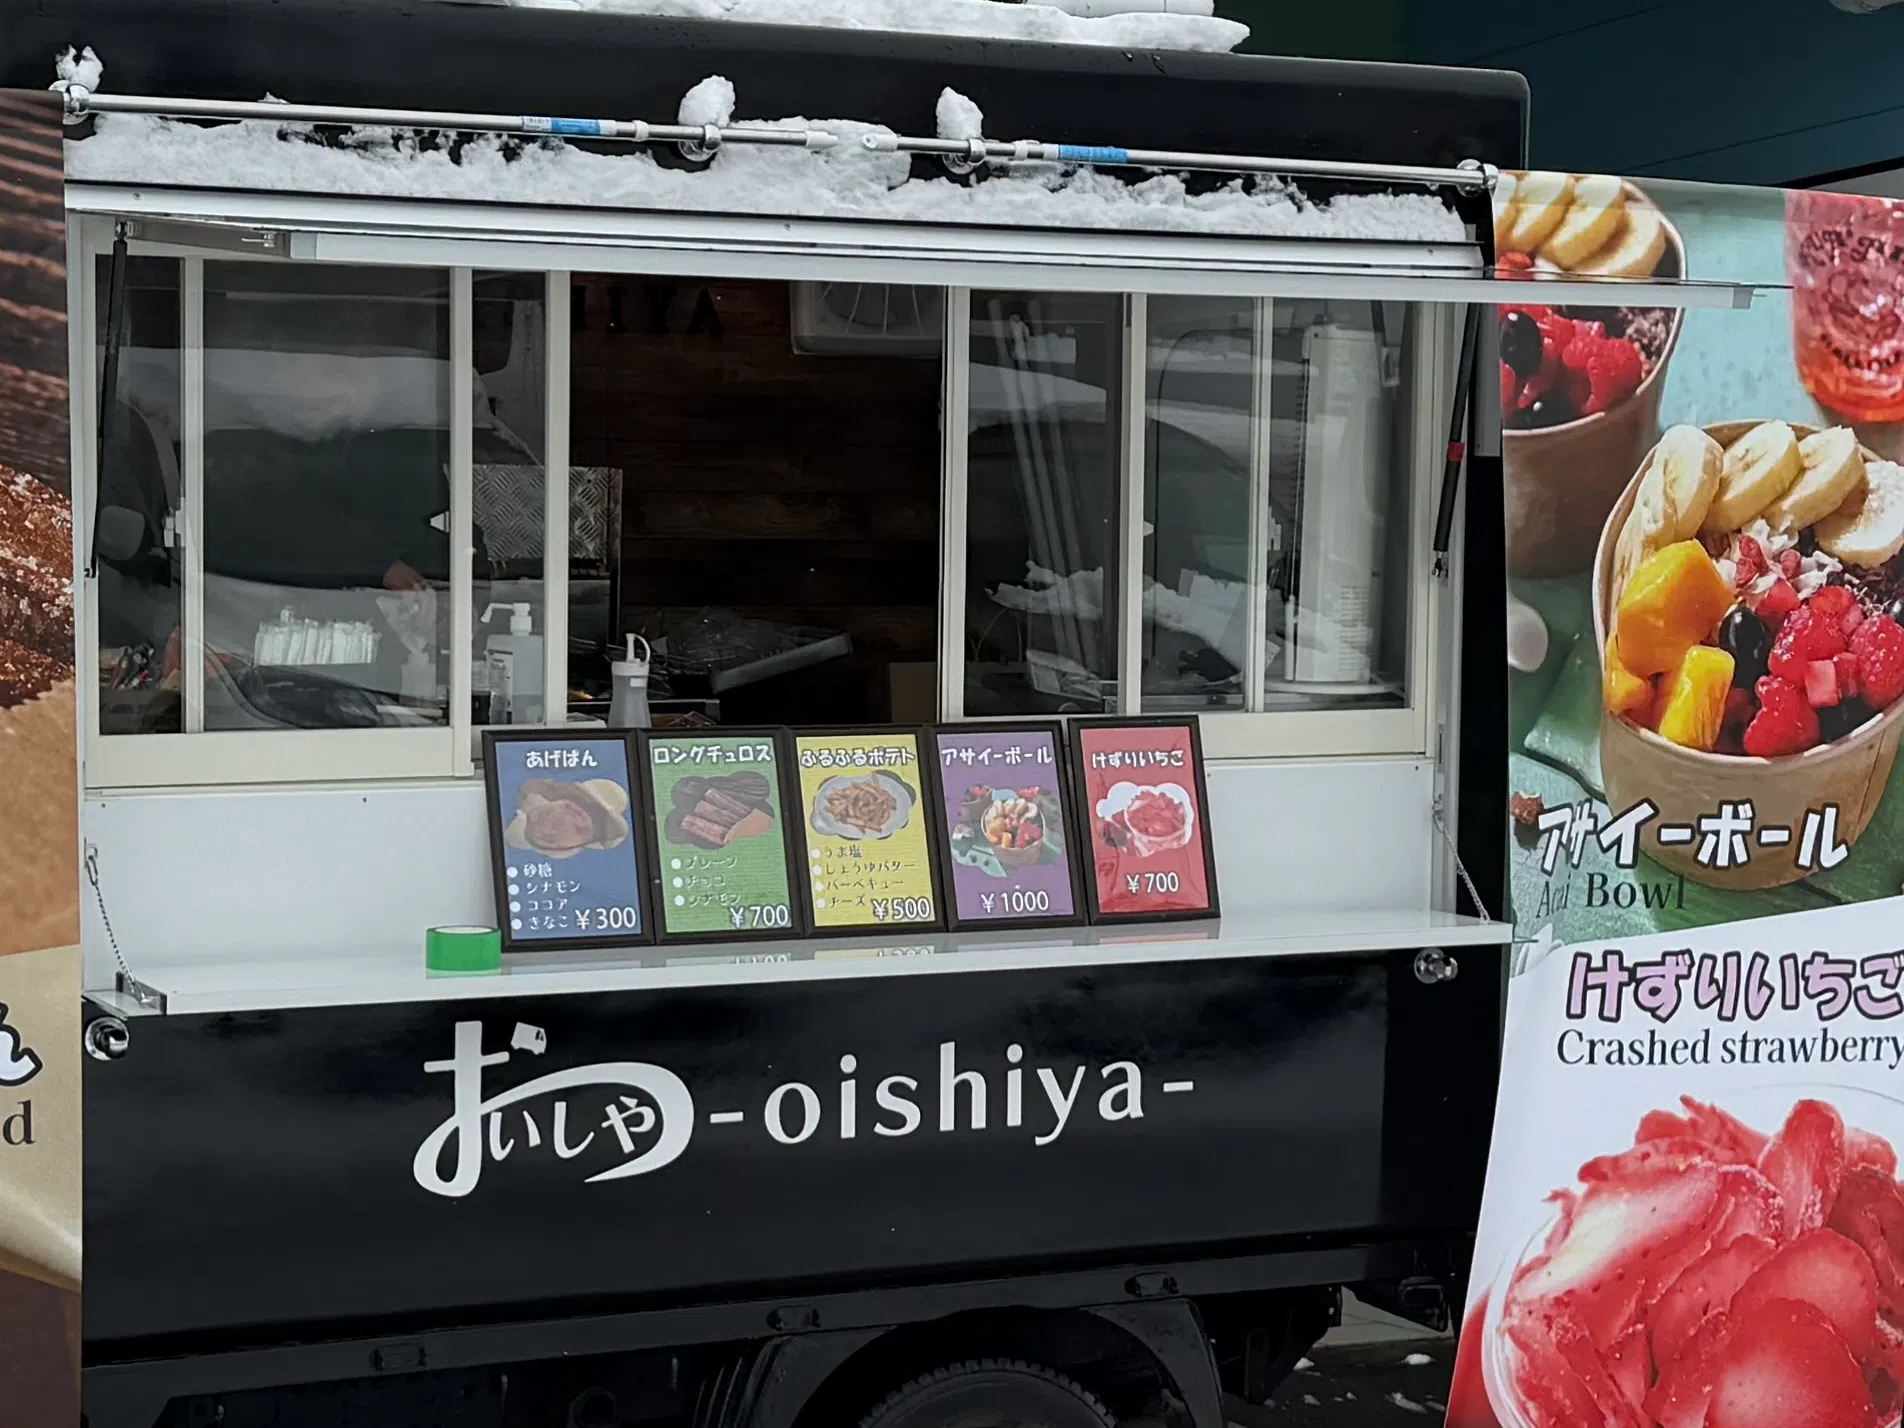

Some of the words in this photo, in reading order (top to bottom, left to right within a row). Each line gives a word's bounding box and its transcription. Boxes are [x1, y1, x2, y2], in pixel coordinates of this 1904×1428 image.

[652, 744, 773, 765] ロングチュロス
[941, 746, 1054, 766] アサイーボール
[1091, 748, 1185, 769] けずりいちご
[1537, 797, 1850, 875] アサイーボール
[522, 862, 553, 878] 砂糖
[526, 880, 581, 896] シナモン
[1126, 872, 1180, 894] ¥700
[1585, 872, 1686, 909] Bowl
[526, 899, 569, 912] ココア
[871, 896, 931, 921] ¥500
[981, 890, 1050, 914] ¥1000
[528, 914, 569, 930] きなこ
[574, 906, 637, 930] ¥300
[728, 904, 790, 928] ¥700
[1556, 1028, 1711, 1067] Crashed
